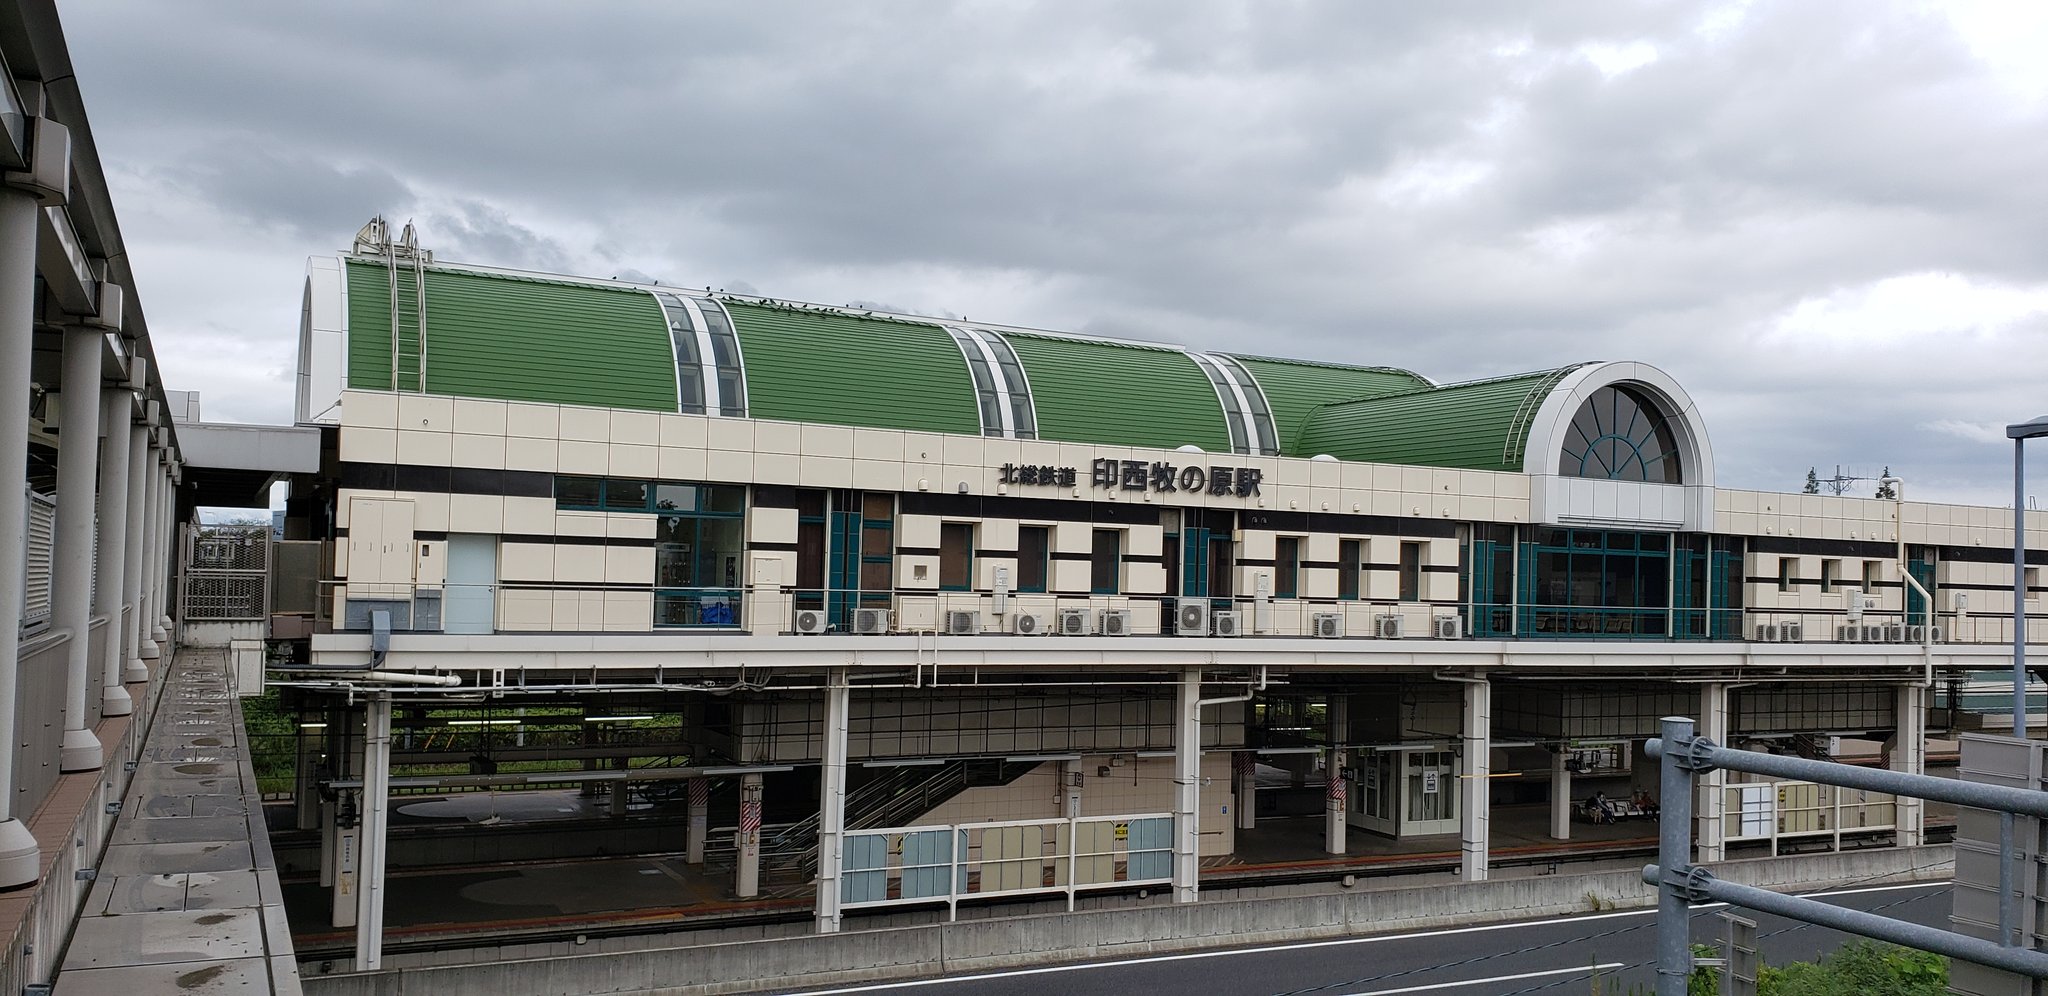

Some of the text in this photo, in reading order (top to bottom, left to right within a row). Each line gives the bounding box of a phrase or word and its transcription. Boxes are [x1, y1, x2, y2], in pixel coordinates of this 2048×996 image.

[999, 457, 1264, 498] 北総鉄道 印西牧の原駅
